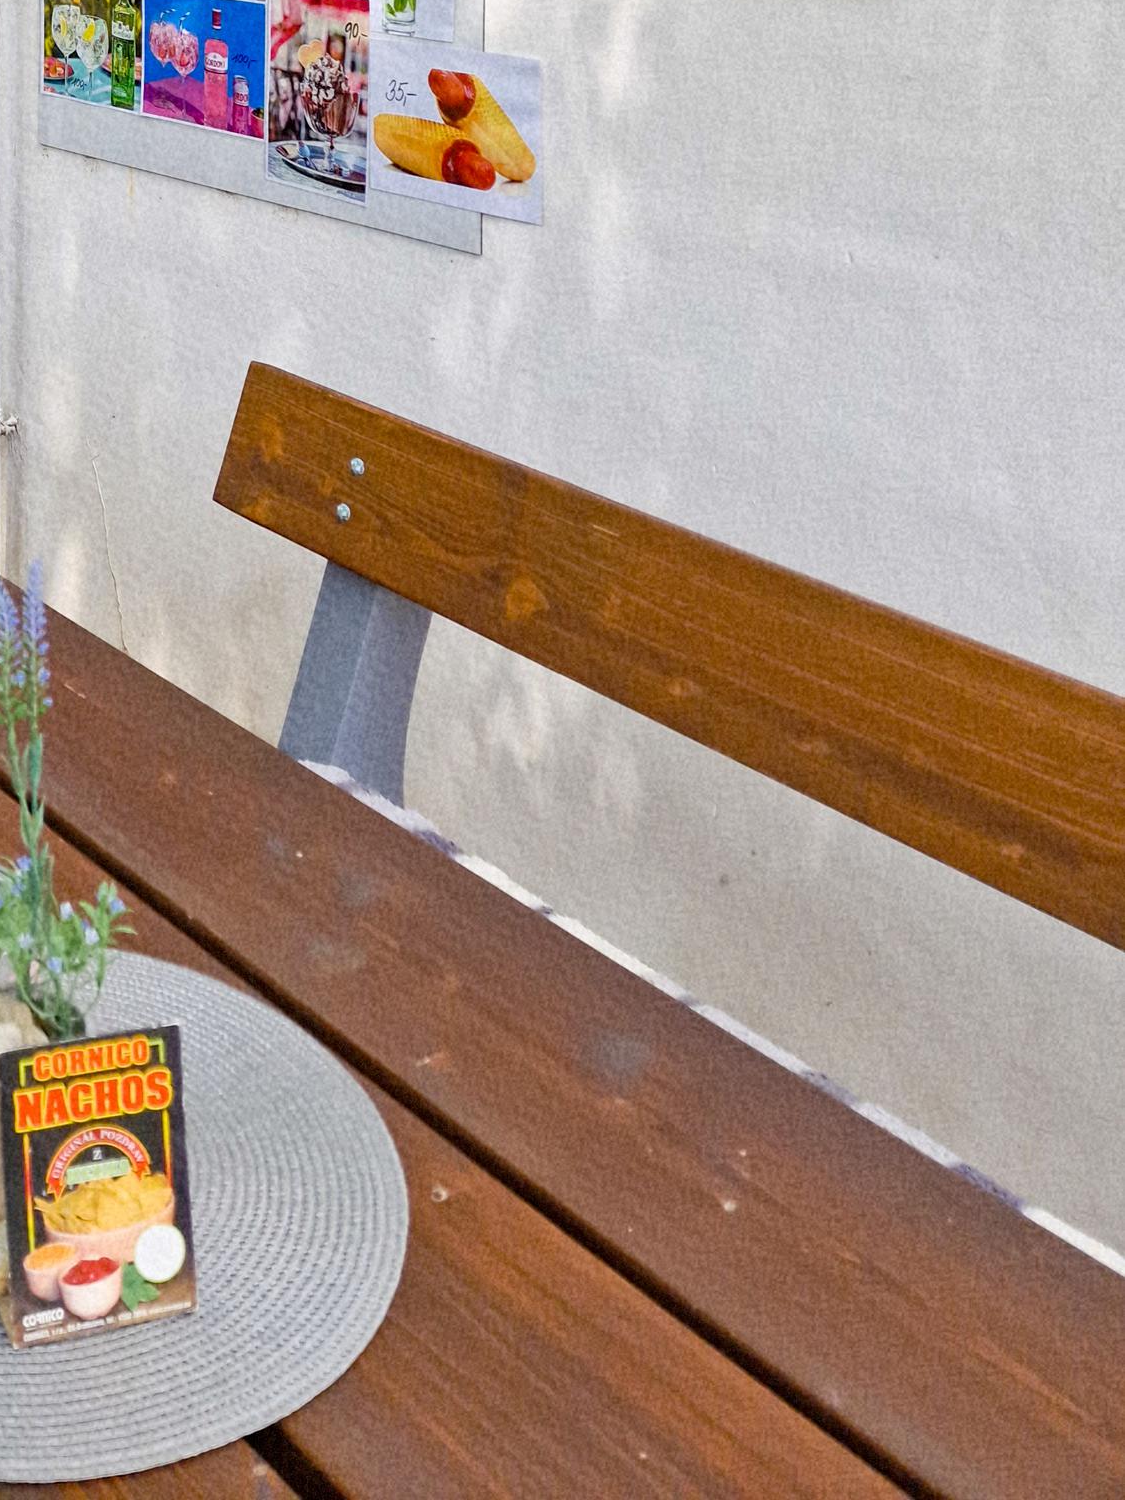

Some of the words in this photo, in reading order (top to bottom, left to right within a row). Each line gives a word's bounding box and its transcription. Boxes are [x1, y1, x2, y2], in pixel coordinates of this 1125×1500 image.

[345, 21, 368, 44] 90,-
[385, 79, 417, 107] 35,-
[32, 1035, 150, 1082] CORNICO
[13, 1068, 173, 1133] NACHOS
